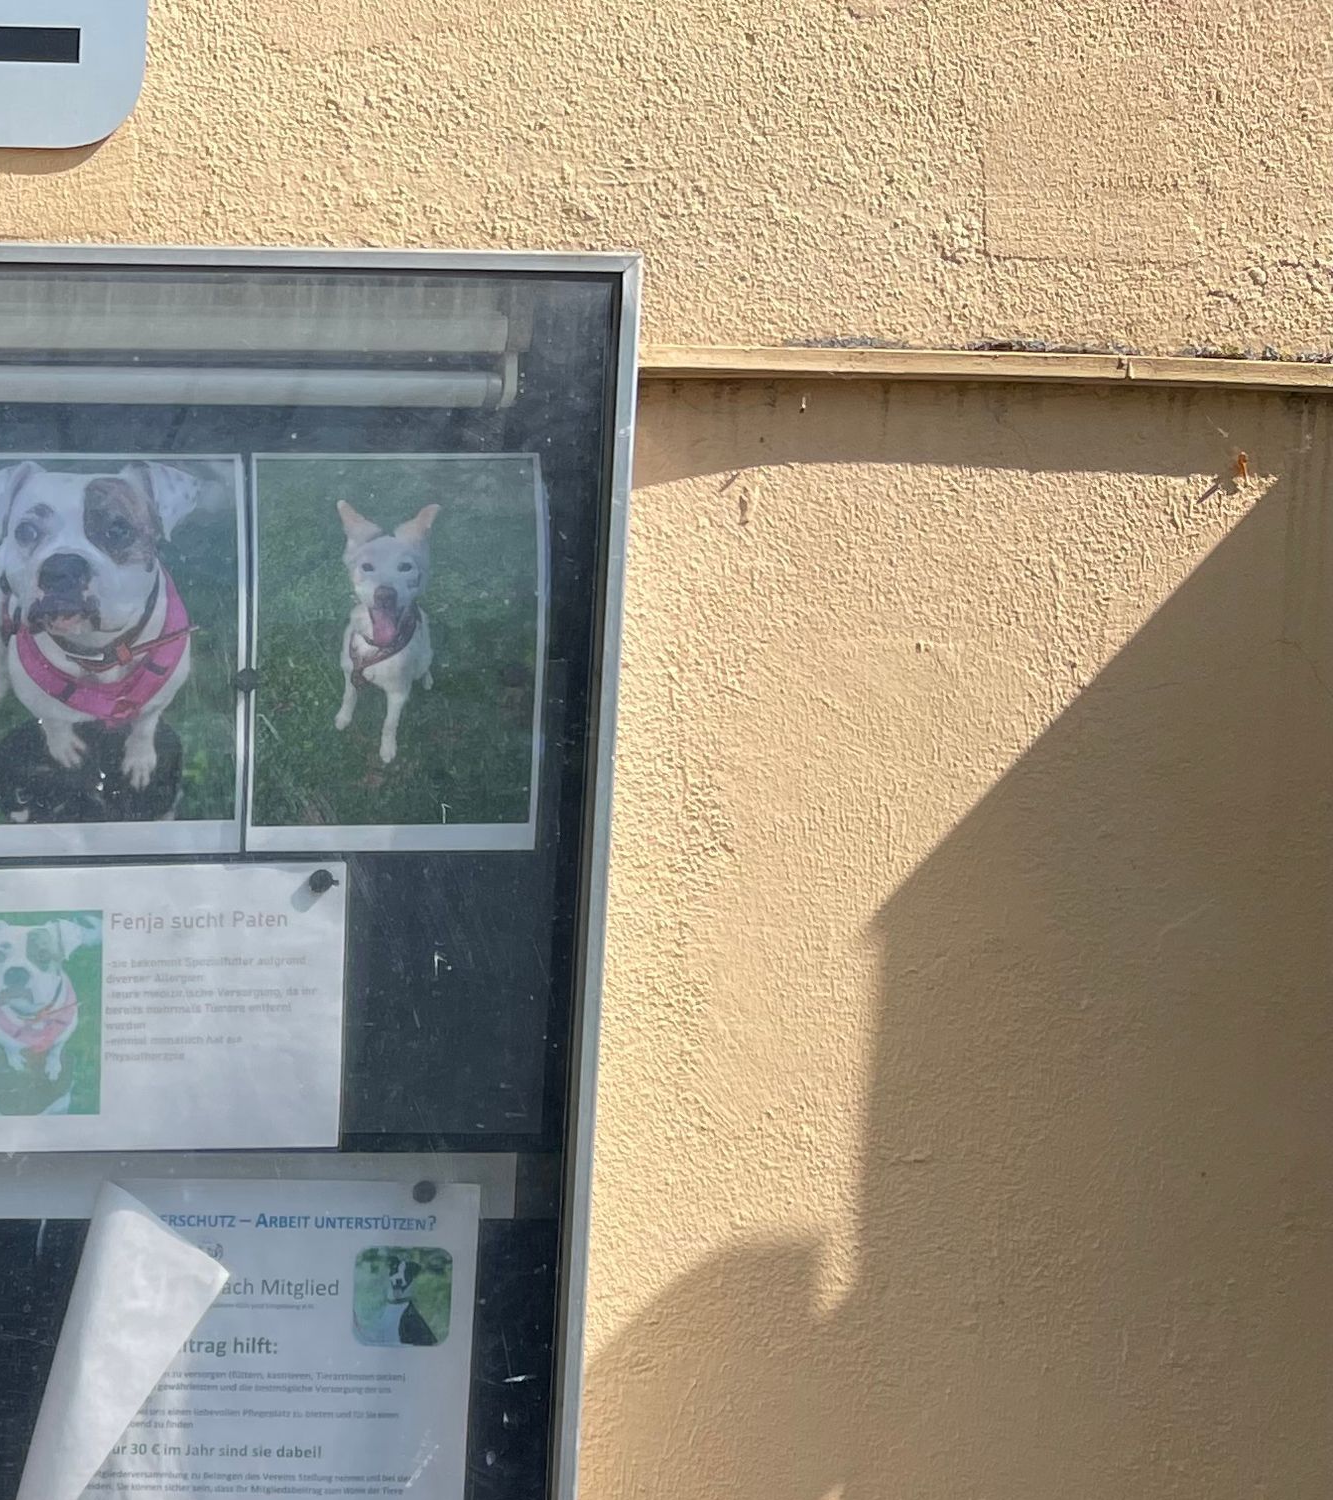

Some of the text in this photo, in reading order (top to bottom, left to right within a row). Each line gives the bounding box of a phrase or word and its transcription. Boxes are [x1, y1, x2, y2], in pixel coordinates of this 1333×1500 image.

[110, 910, 289, 934] Fenja sucht Paten
[131, 957, 182, 969] bekommt
[256, 955, 307, 968] aufgrund
[314, 1214, 437, 1232] UNTERSTÜTZEN?
[224, 1277, 341, 1300] ach Mitglied
[182, 1336, 278, 1358] itrag hilft:
[111, 1443, 322, 1459] ur 30 € im Jahr sind sie dabei!
